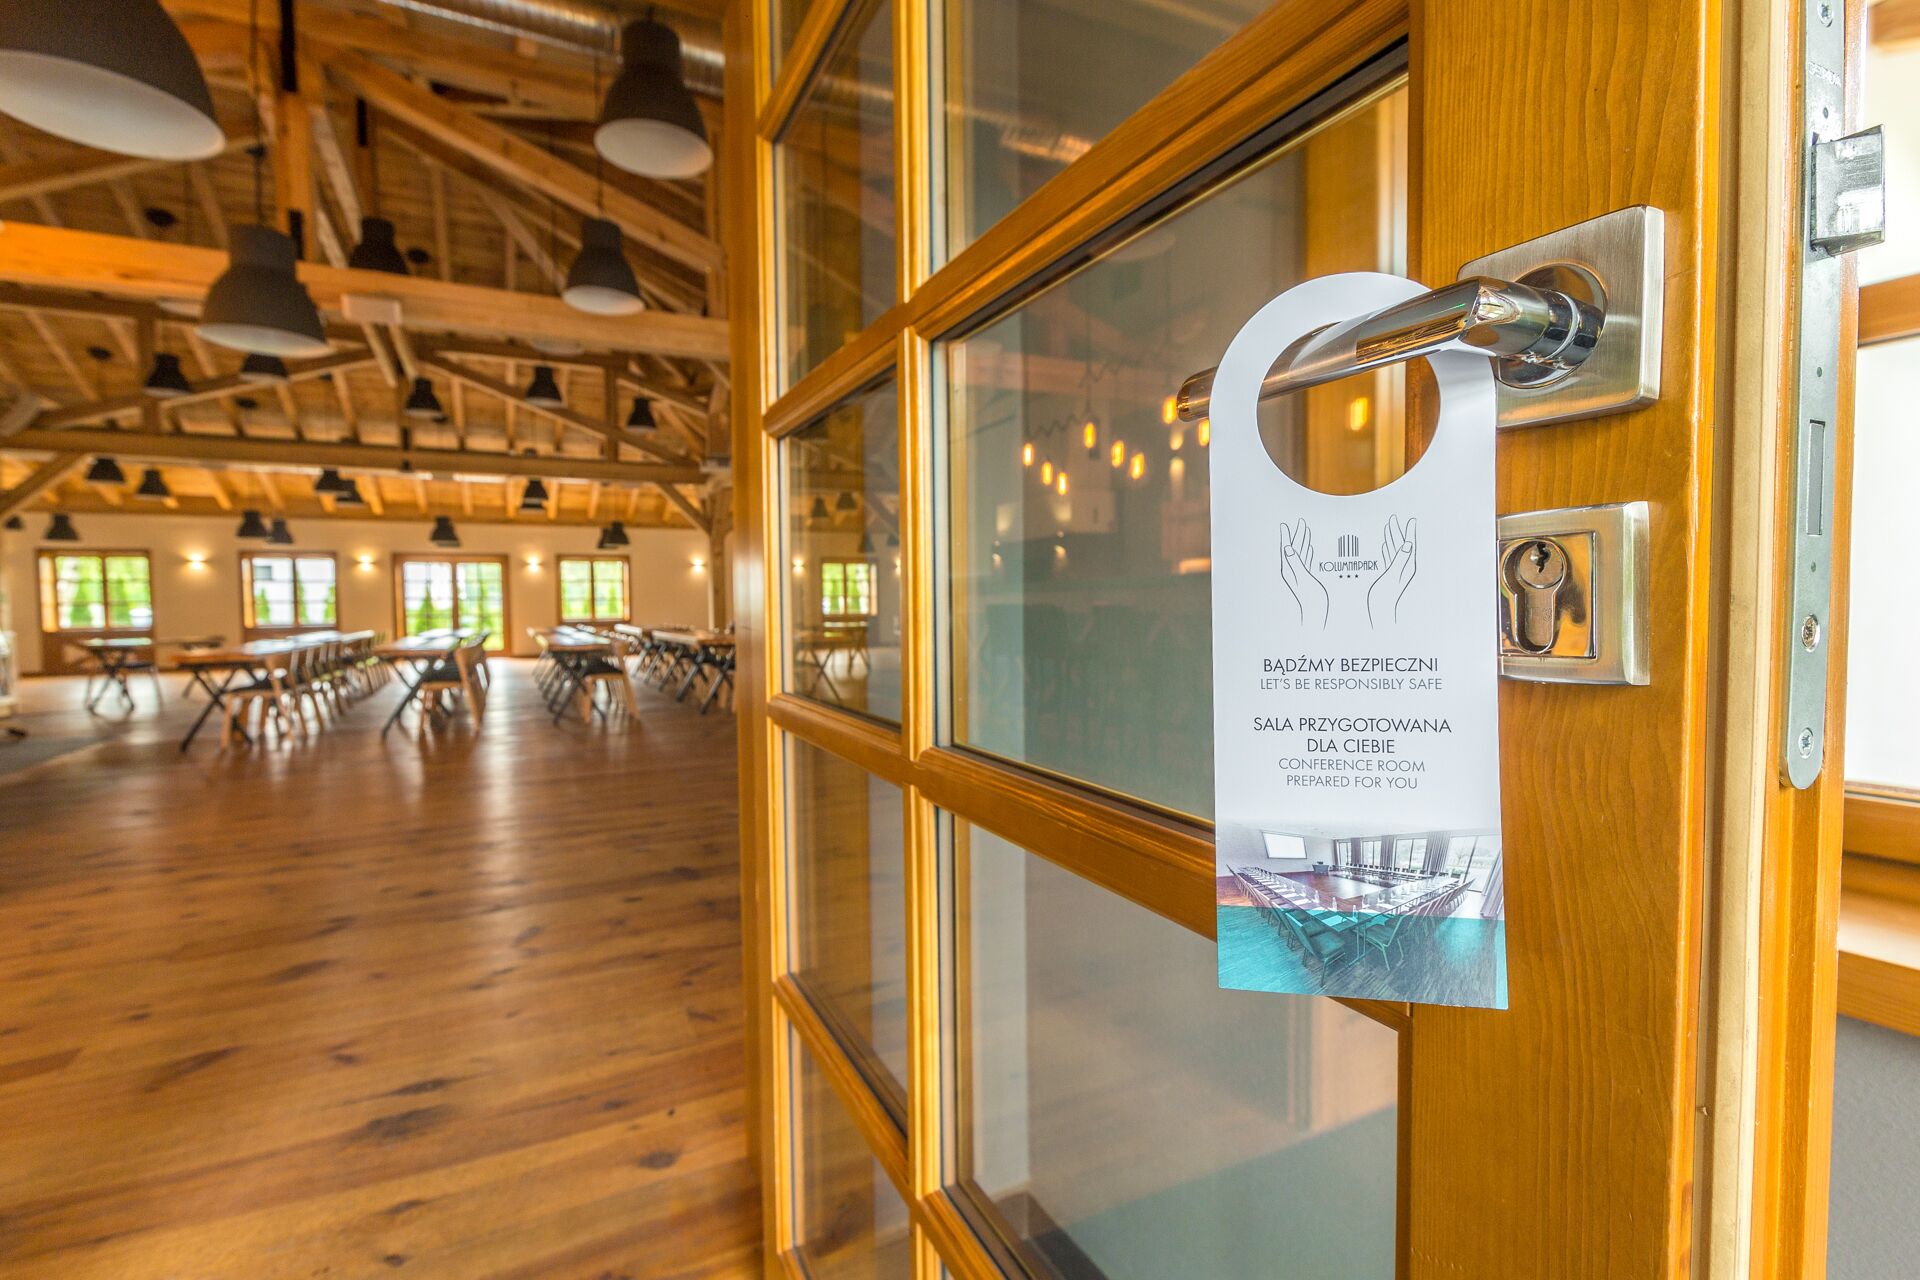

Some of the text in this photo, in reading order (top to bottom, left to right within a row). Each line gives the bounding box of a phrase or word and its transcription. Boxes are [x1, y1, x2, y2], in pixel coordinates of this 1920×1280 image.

[1319, 560, 1379, 572] KOLUMNAPARK
[1263, 655, 1438, 675] BĄDŹMY BEZPIECZNI
[1295, 678, 1310, 690] BE
[1315, 678, 1404, 690] RESPONSIBLY
[1409, 678, 1442, 690] SAFE
[1254, 717, 1452, 733] SALA PRZYGOTOWANA
[1307, 738, 1395, 753] DLA CIEBIE
[1279, 758, 1425, 772] CONFERENCE ROOM
[1286, 775, 1418, 789] PREPARED FOR YOU
